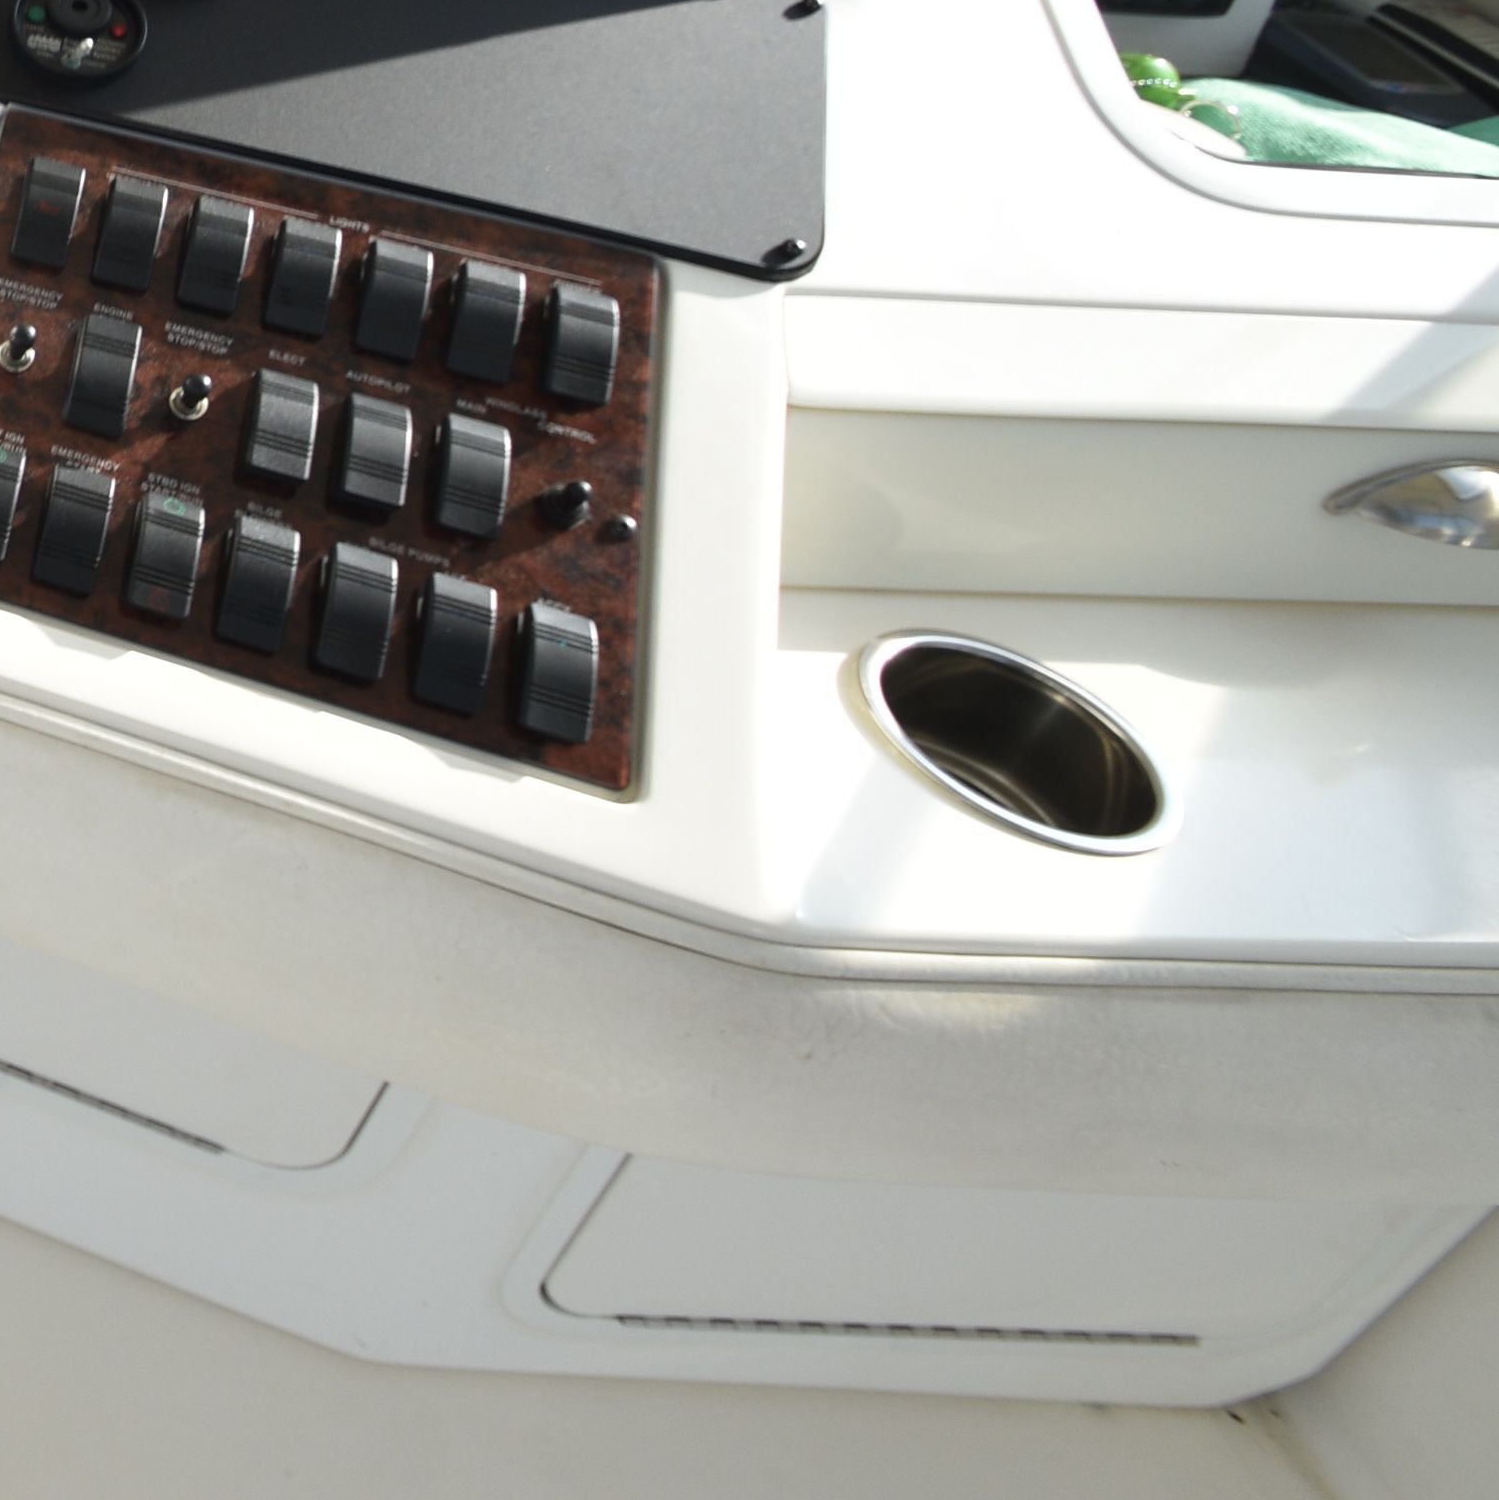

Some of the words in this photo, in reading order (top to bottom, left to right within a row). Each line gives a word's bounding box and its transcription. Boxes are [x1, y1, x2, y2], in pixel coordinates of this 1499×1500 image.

[93, 302, 135, 321] ENGINE
[164, 321, 234, 347] EMERGENCY
[345, 369, 411, 394] AUTOPILOT
[5, 430, 25, 445] IGN
[538, 420, 597, 445] CONTROL
[50, 444, 121, 472] EMERGENCY
[147, 471, 178, 488] STBD
[179, 481, 201, 496] IGN
